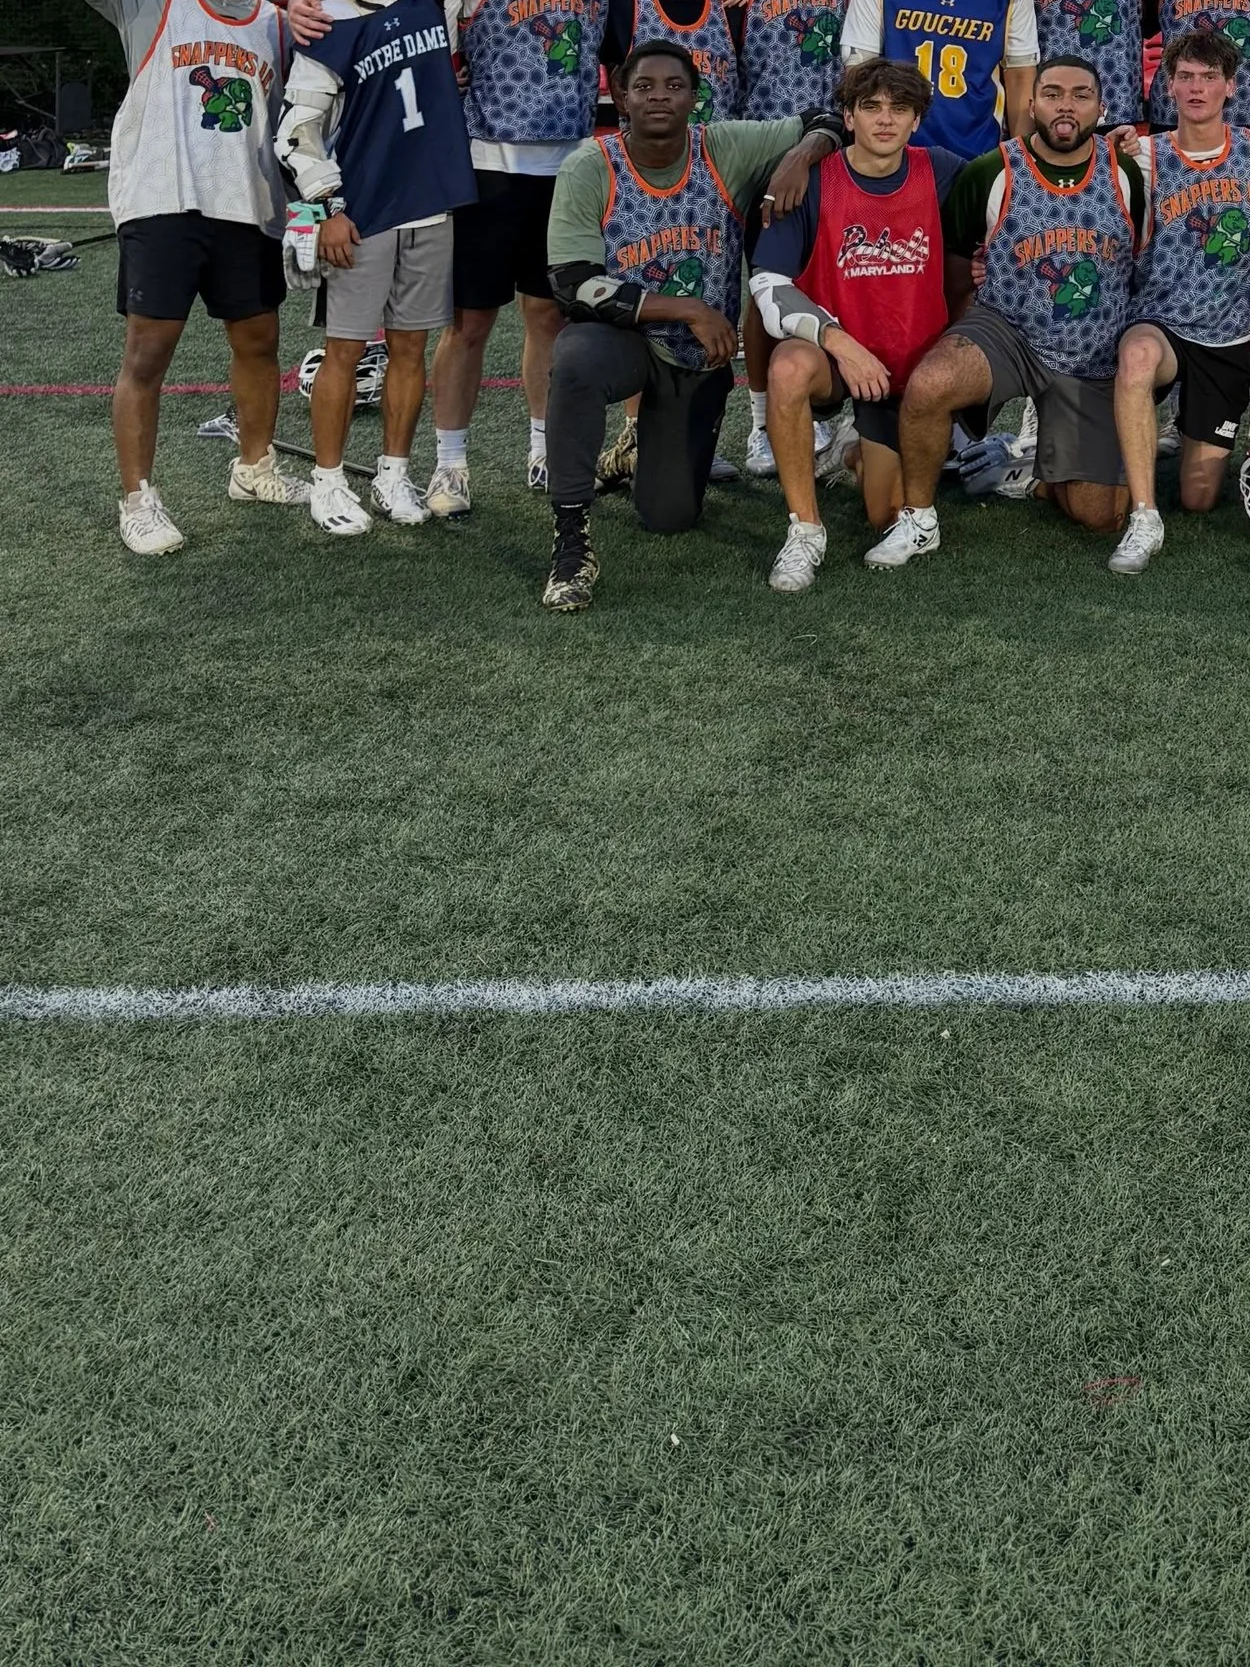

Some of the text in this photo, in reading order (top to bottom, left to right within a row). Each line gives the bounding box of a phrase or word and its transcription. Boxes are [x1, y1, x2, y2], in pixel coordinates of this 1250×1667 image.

[895, 9, 994, 42] GOUCHER
[354, 25, 448, 85] NOTRE DAME
[915, 40, 968, 98] 18
[394, 66, 425, 133] 1
[1160, 179, 1242, 225] SNAPPERS
[617, 227, 721, 273] SNAPPERS LC
[837, 224, 929, 268] Rebels
[1015, 227, 1097, 269] SNAPPERS
[850, 264, 915, 277] MARYLAND
